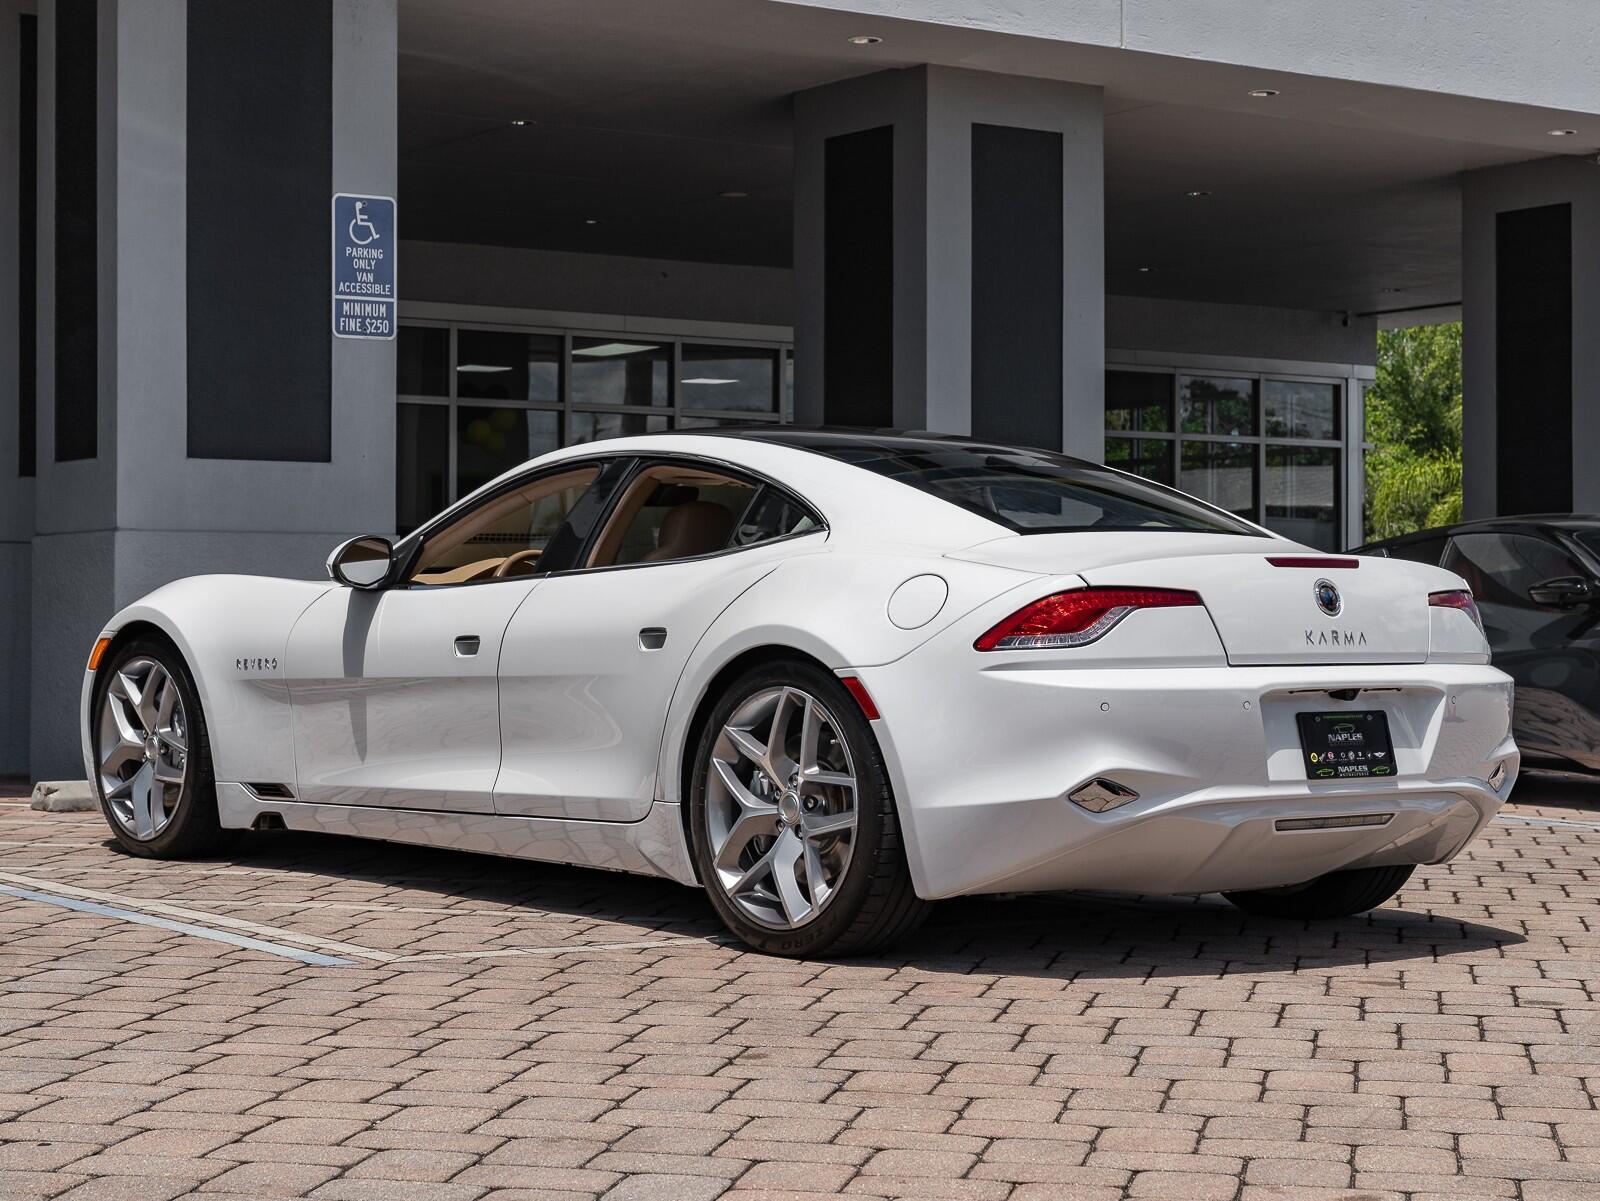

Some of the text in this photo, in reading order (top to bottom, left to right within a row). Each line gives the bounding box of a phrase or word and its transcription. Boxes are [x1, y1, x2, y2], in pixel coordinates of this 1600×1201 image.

[345, 246, 384, 259] PARKING
[353, 258, 376, 270] ONLY
[356, 271, 374, 283] VAN
[338, 281, 391, 295] ACCESSIBLE
[343, 302, 387, 318] MINIMUM
[340, 317, 390, 334] FINE $250
[1304, 629, 1367, 646] KARMA
[236, 657, 278, 671] REVERO
[1327, 732, 1364, 742] NAPLES
[1337, 764, 1368, 773] NAPLES
